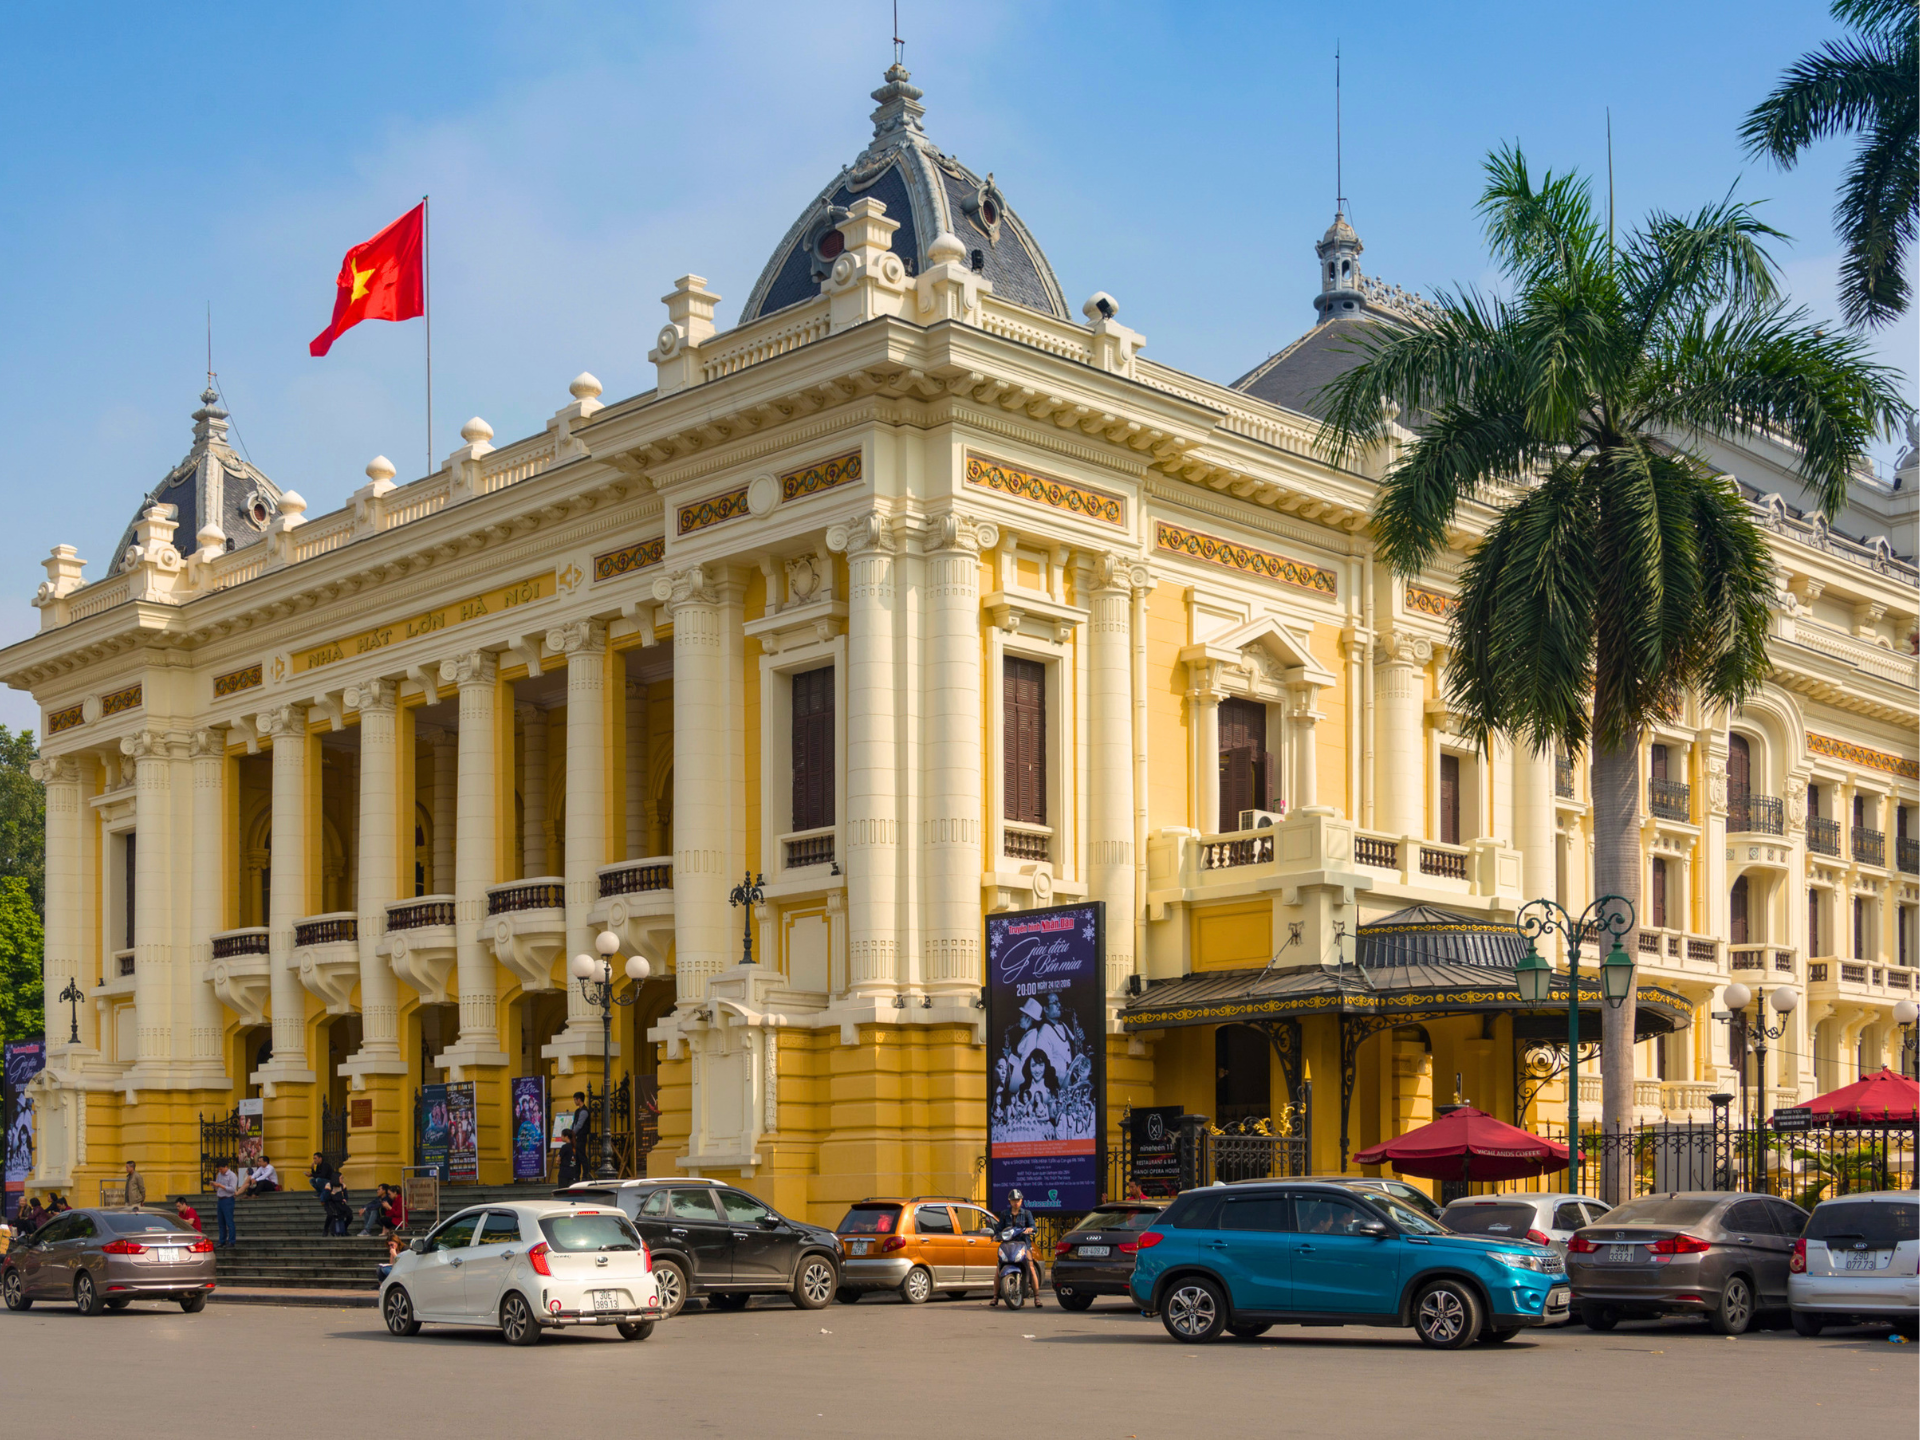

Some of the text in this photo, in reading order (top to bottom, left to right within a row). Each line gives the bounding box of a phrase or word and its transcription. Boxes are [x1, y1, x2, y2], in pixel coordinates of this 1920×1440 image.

[308, 641, 344, 668] NHÀ
[357, 629, 392, 654] HÁT
[406, 612, 445, 638] LỚN
[461, 595, 488, 621] HÀ
[1016, 982, 1036, 996] 20:00
[1616, 1244, 1629, 1252] 30A
[1854, 1252, 1869, 1260] 29D
[600, 1290, 612, 1300] 30E
